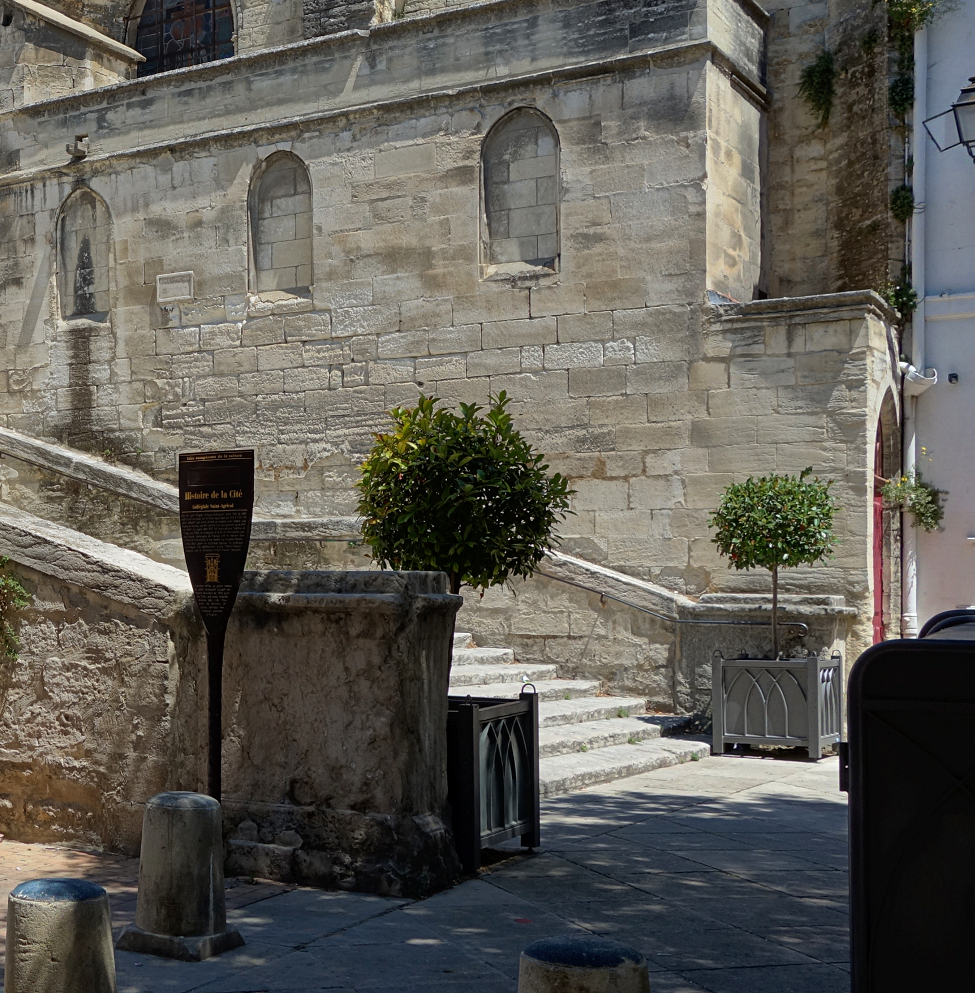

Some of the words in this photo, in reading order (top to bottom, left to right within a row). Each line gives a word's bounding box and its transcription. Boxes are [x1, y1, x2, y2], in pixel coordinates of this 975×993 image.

[184, 491, 209, 500] Histoire
[210, 490, 220, 499] de
[221, 490, 228, 498] la
[229, 489, 243, 498] Cité
